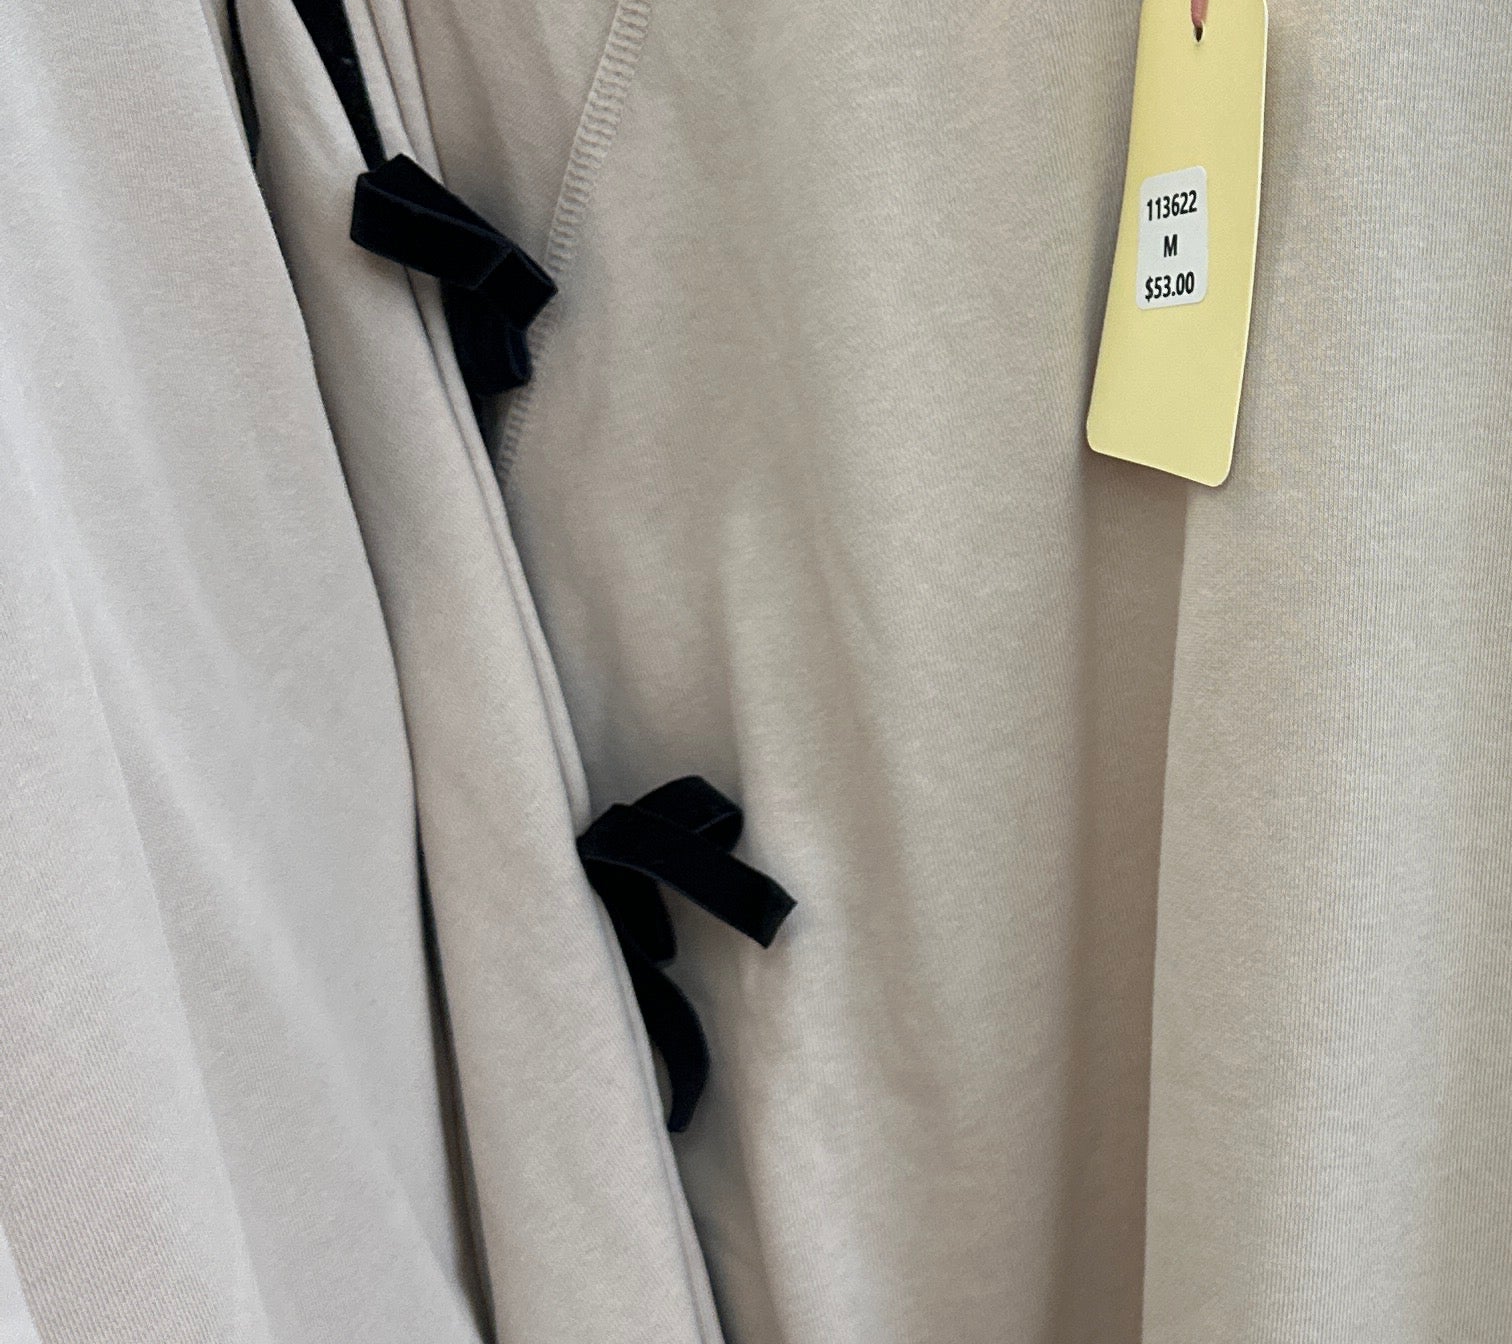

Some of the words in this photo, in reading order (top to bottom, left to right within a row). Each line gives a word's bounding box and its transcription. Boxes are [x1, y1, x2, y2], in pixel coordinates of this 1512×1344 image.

[1147, 190, 1198, 222] 113622
[1163, 233, 1178, 258] M
[1144, 271, 1195, 303] $53.00
